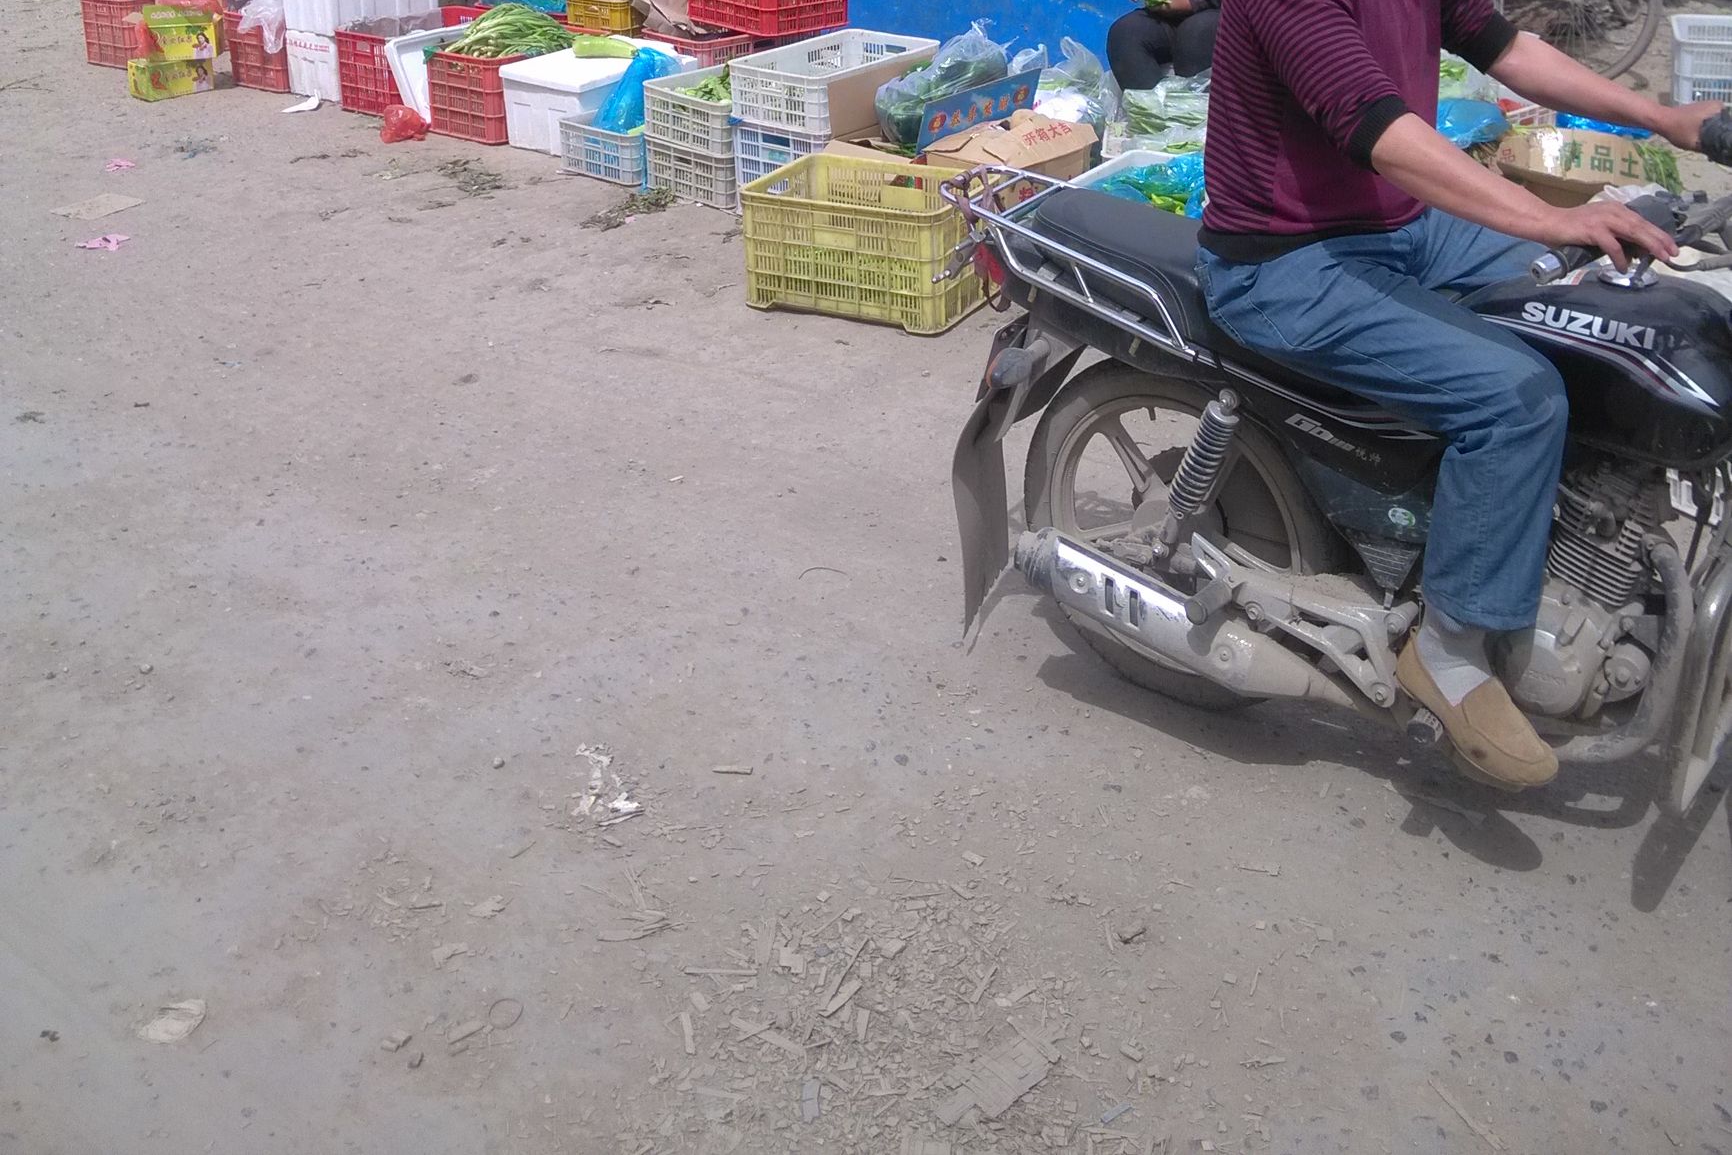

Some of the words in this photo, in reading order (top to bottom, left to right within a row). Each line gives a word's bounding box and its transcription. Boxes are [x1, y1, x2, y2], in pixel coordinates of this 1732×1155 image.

[1021, 121, 1072, 146] 开箱大吉
[1521, 300, 1656, 350] SUZUKI
